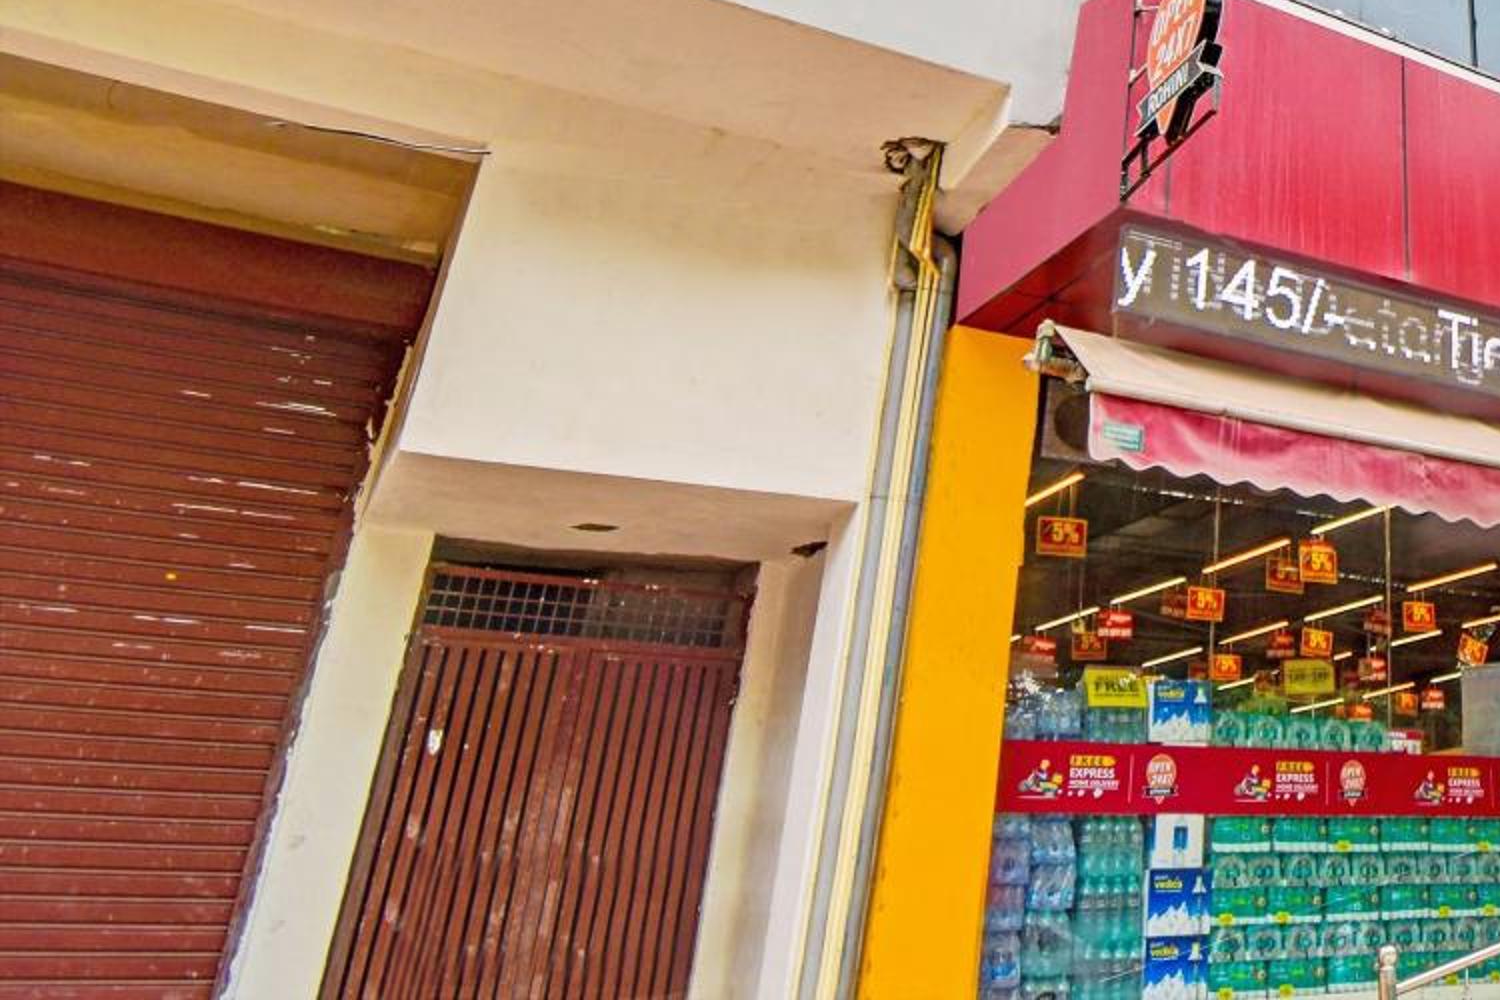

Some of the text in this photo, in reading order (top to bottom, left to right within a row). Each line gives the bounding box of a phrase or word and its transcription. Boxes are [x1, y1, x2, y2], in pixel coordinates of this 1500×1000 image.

[1051, 521, 1079, 544] 5%
[1311, 551, 1333, 571] 5%
[1070, 767, 1115, 778] EXPRESS
[1276, 774, 1315, 783] EXPRESS
